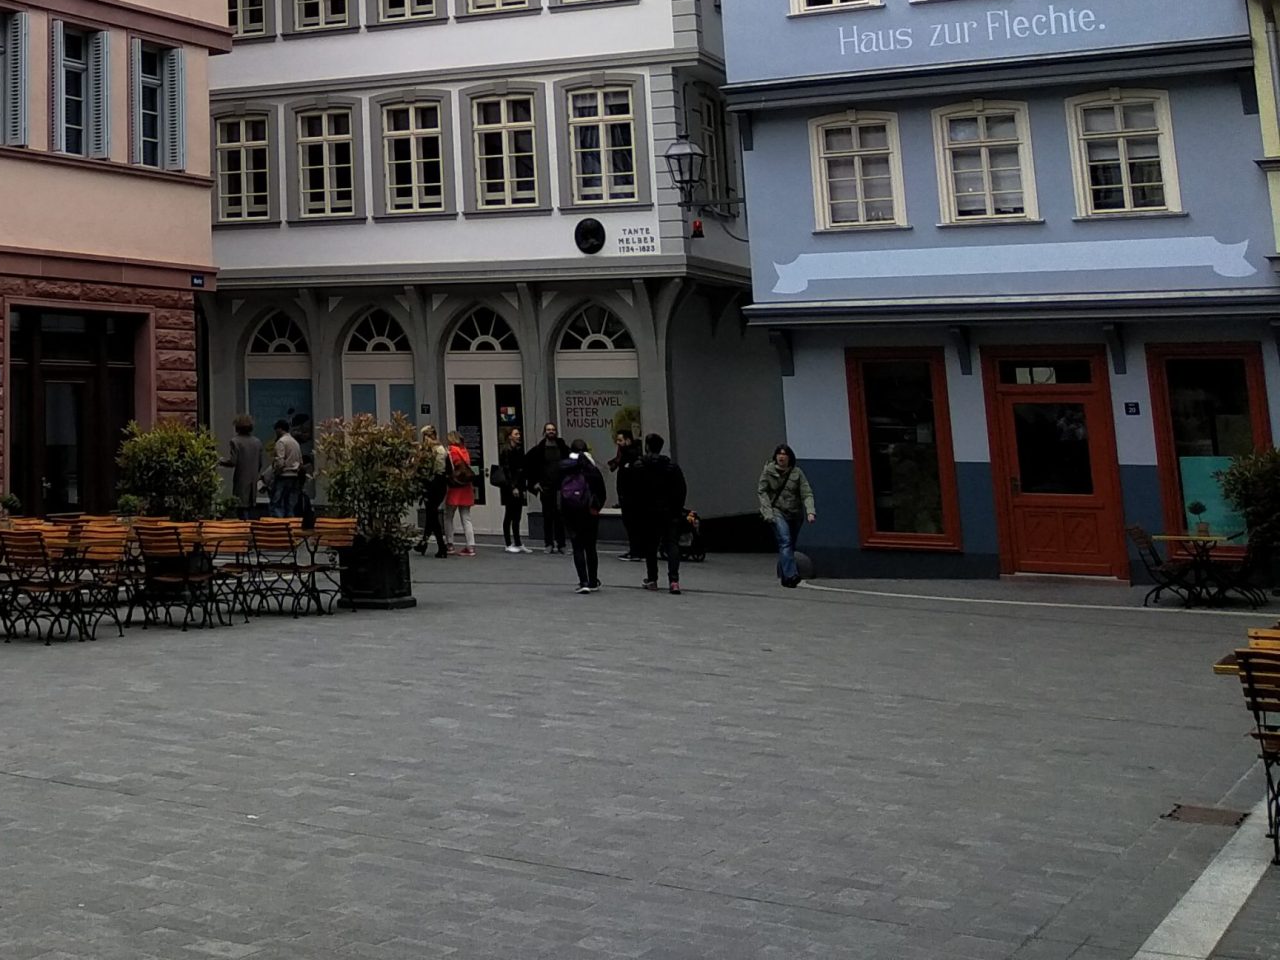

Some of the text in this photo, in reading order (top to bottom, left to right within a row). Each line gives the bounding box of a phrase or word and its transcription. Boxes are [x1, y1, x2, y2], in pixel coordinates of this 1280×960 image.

[838, 5, 1106, 55] Haus zur Flechte.
[622, 227, 651, 235] TANTE
[618, 236, 655, 245] MELBER
[565, 396, 622, 407] STRUWWEL
[566, 407, 599, 417] PETER
[567, 418, 613, 429] MUSEUM
